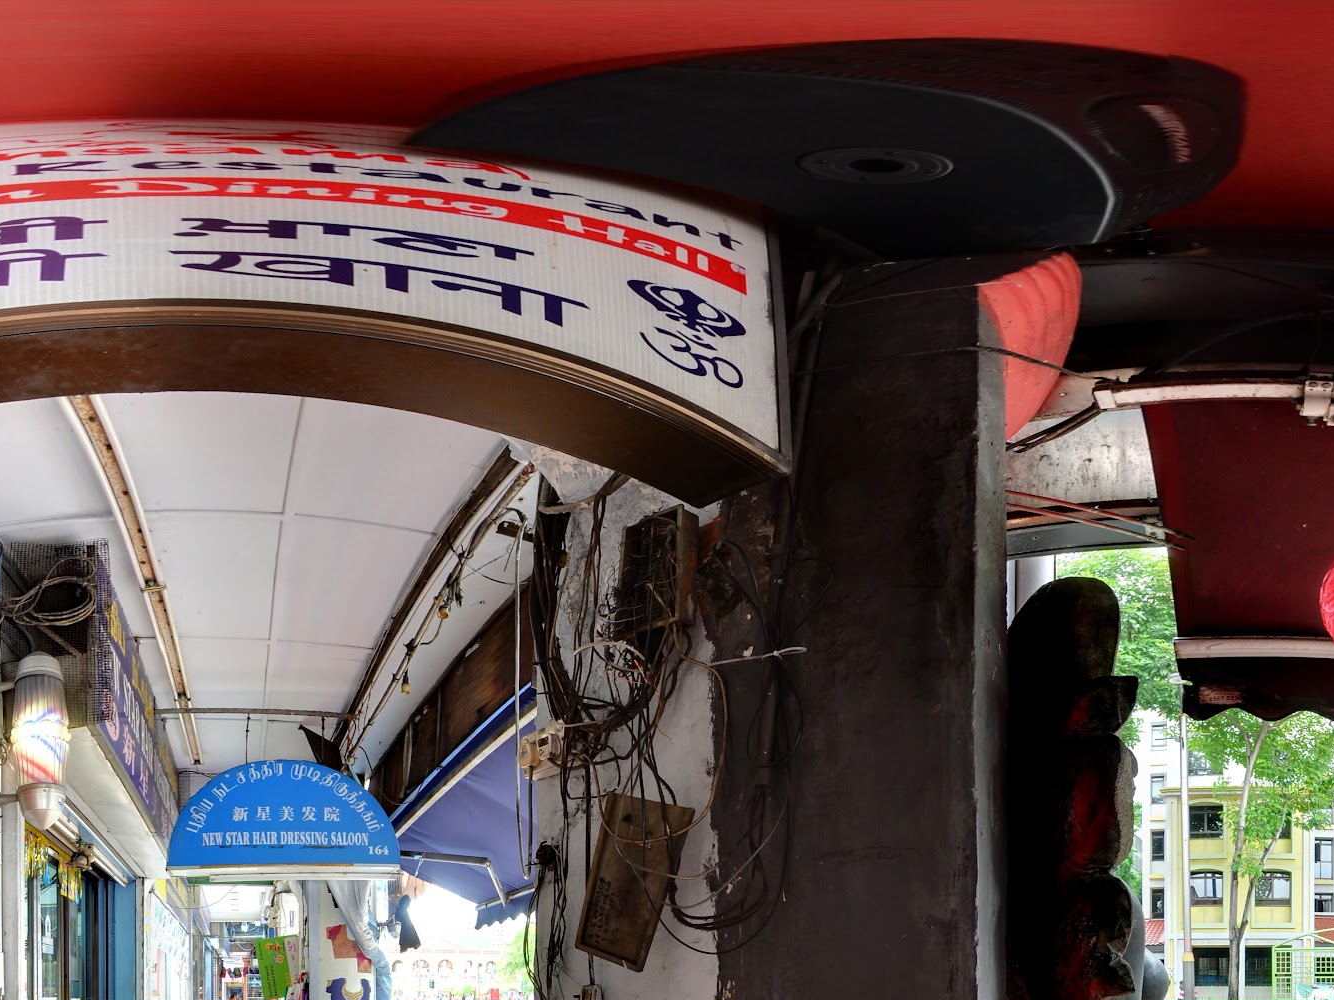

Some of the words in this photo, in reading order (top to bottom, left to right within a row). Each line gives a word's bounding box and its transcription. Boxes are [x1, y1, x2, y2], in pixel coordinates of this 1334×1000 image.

[13, 159, 744, 252] Restaurant
[91, 179, 509, 220] Dining
[547, 211, 712, 273] Hall
[168, 250, 590, 327] खाना
[232, 805, 342, 822] 新星美发院
[201, 831, 224, 846] NEW
[225, 831, 251, 846] STAR
[252, 831, 278, 846] HAIR
[279, 831, 329, 846] DRESSING
[330, 831, 370, 847] SALOON
[368, 845, 390, 856] 164
